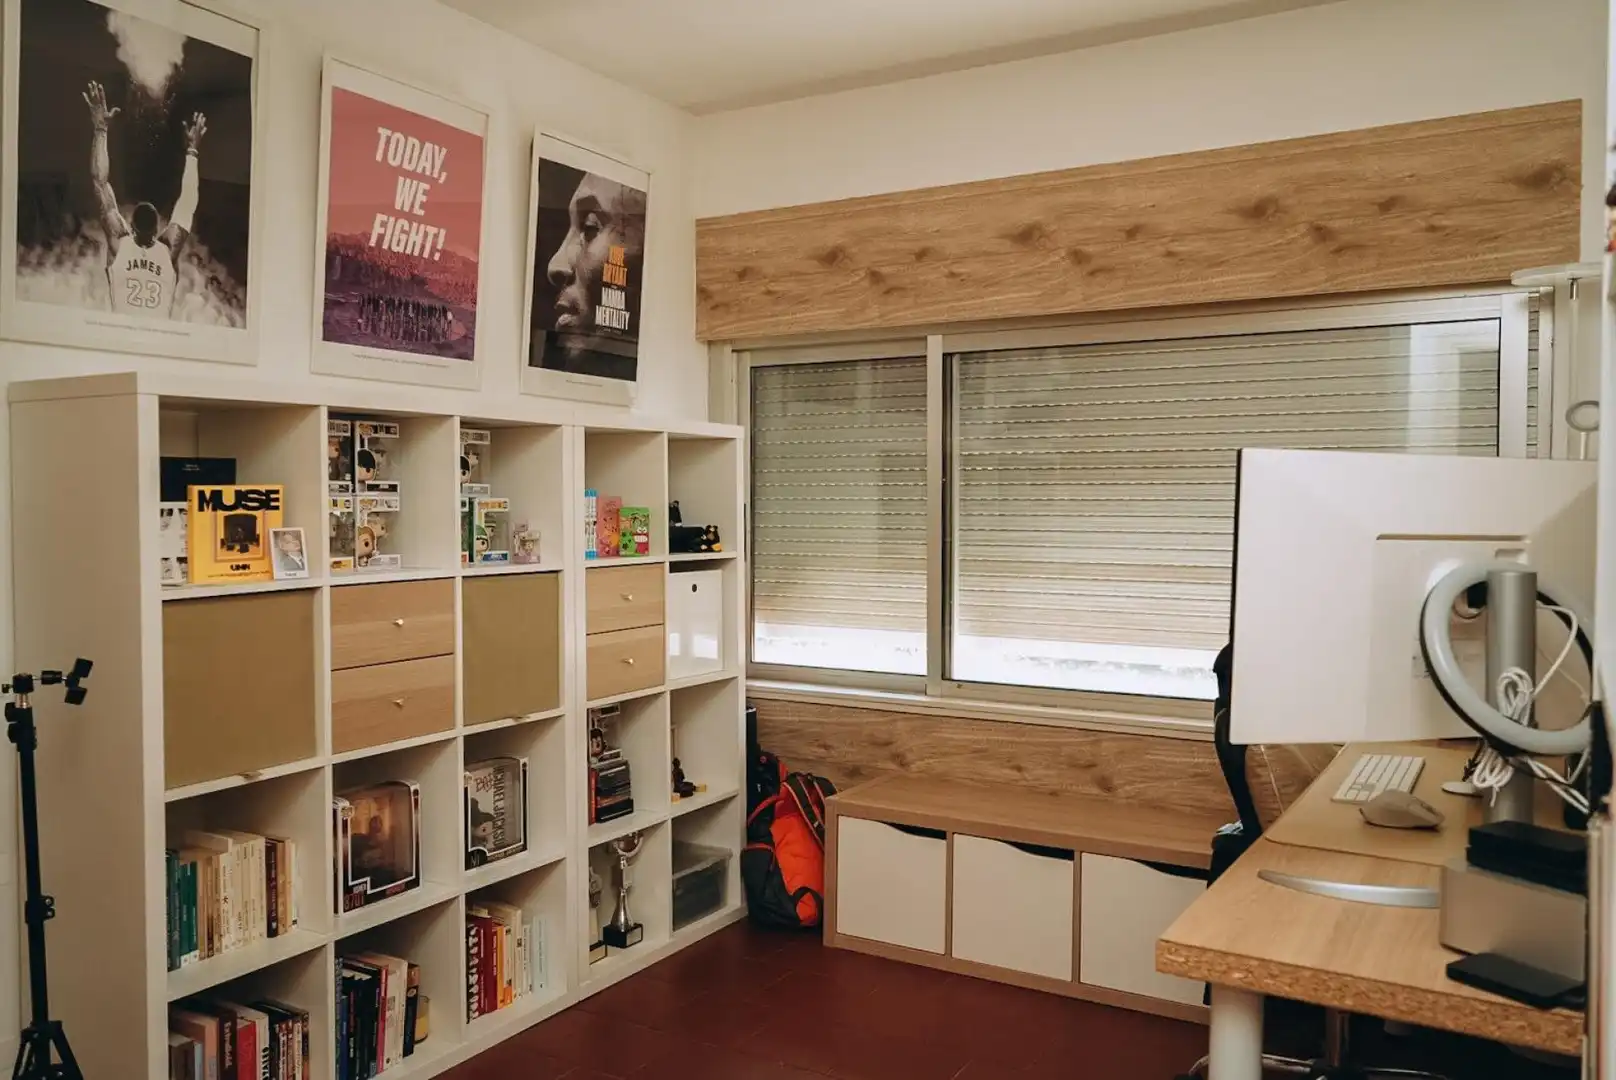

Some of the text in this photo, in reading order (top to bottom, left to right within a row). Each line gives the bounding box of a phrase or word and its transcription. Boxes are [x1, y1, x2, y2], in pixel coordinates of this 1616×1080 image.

[376, 126, 447, 184] TODAY,
[394, 176, 431, 216] WE
[369, 212, 446, 261] FIGHT!
[126, 259, 162, 276] JAMES
[126, 277, 161, 309] 23
[595, 304, 630, 331] MENTALITY
[198, 489, 280, 512] MUSE
